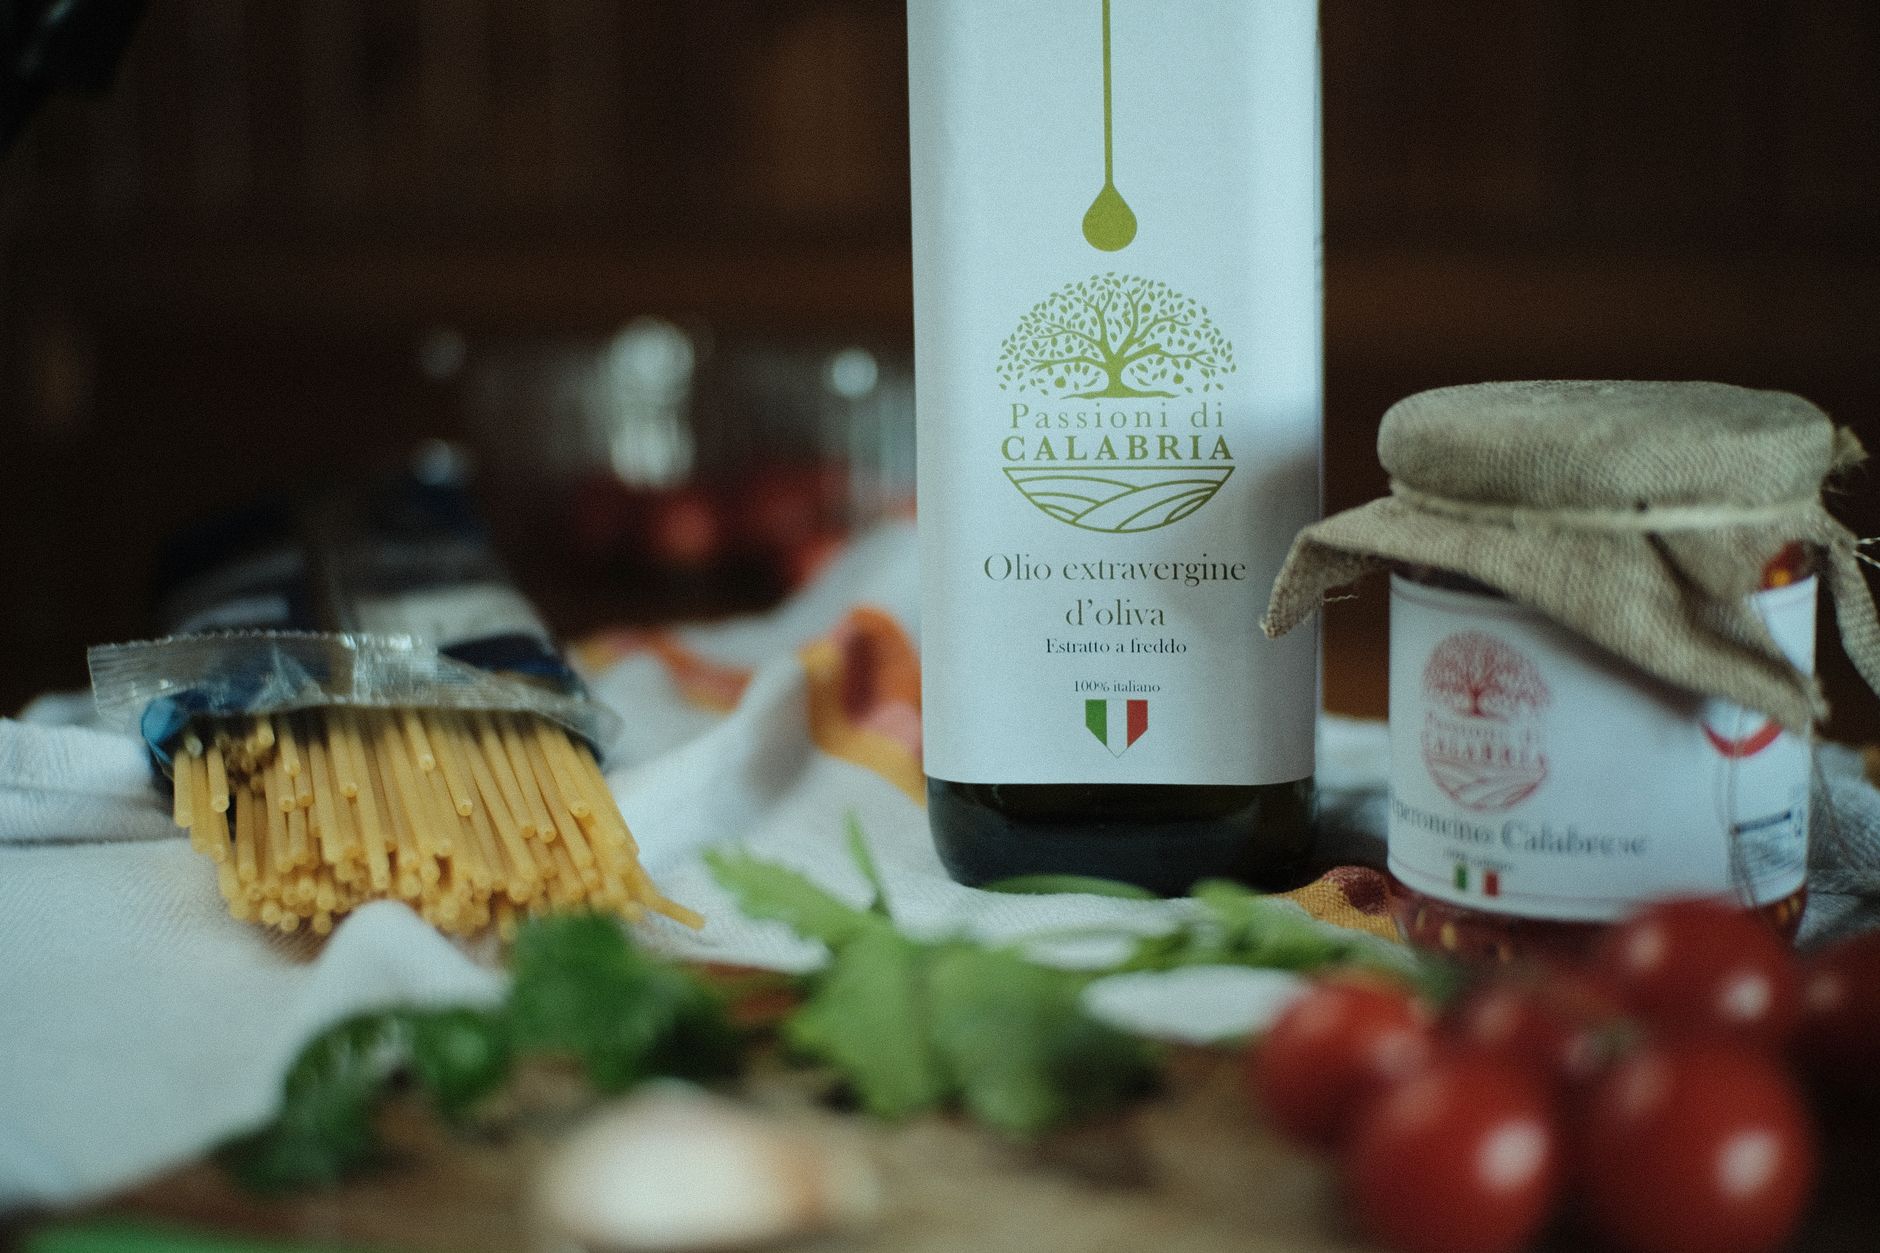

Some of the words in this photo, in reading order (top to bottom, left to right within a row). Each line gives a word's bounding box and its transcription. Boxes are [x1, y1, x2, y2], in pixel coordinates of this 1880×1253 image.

[1009, 402, 1169, 429] Passioni
[1189, 402, 1225, 428] di
[1001, 434, 1234, 462] CALABRIA
[983, 552, 1052, 581] Olio
[1062, 553, 1247, 588] extravergine
[1065, 599, 1166, 627] d’oliva
[1046, 638, 1110, 654] Estratto
[1115, 642, 1125, 654] a
[1130, 638, 1187, 654] freddo
[1074, 680, 1110, 693] 100%
[1113, 680, 1161, 693] italiano
